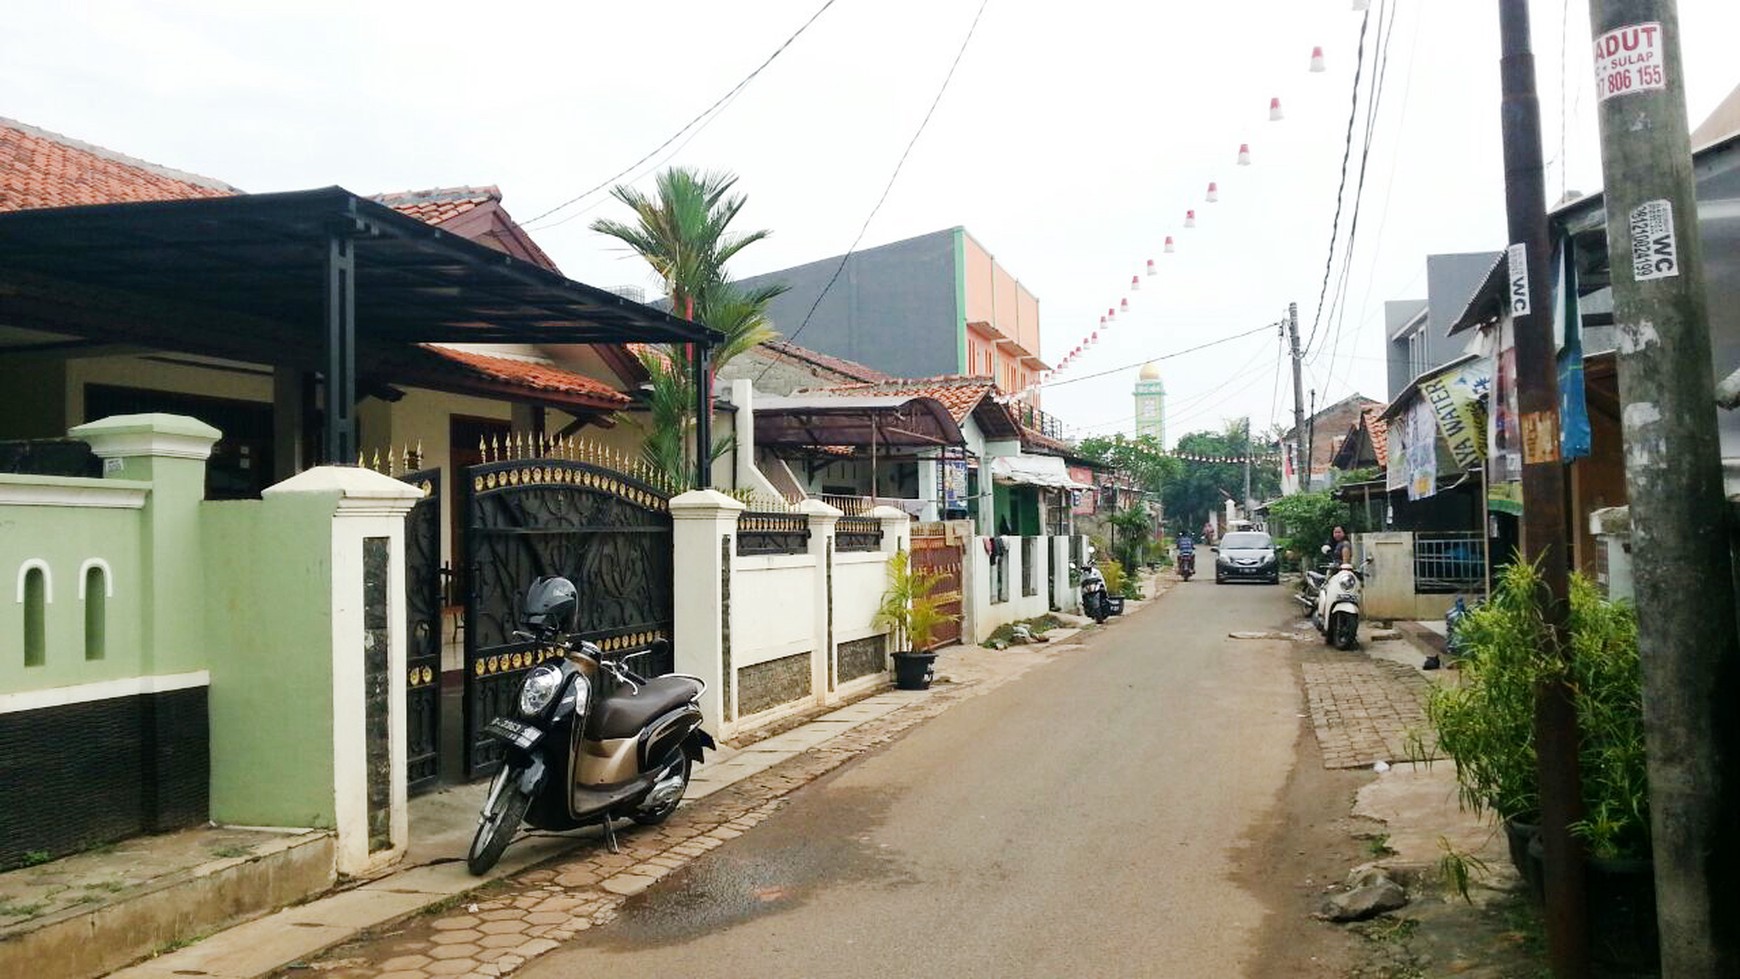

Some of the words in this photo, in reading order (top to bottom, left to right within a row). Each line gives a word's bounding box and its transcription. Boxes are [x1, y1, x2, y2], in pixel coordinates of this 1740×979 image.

[1594, 26, 1657, 63] ADUT
[1611, 52, 1654, 70] SULAP
[1607, 69, 1632, 94] 806
[1637, 65, 1662, 86] 155
[1653, 234, 1674, 273] WC
[1512, 276, 1527, 313] WC
[1425, 379, 1467, 438] WATER
